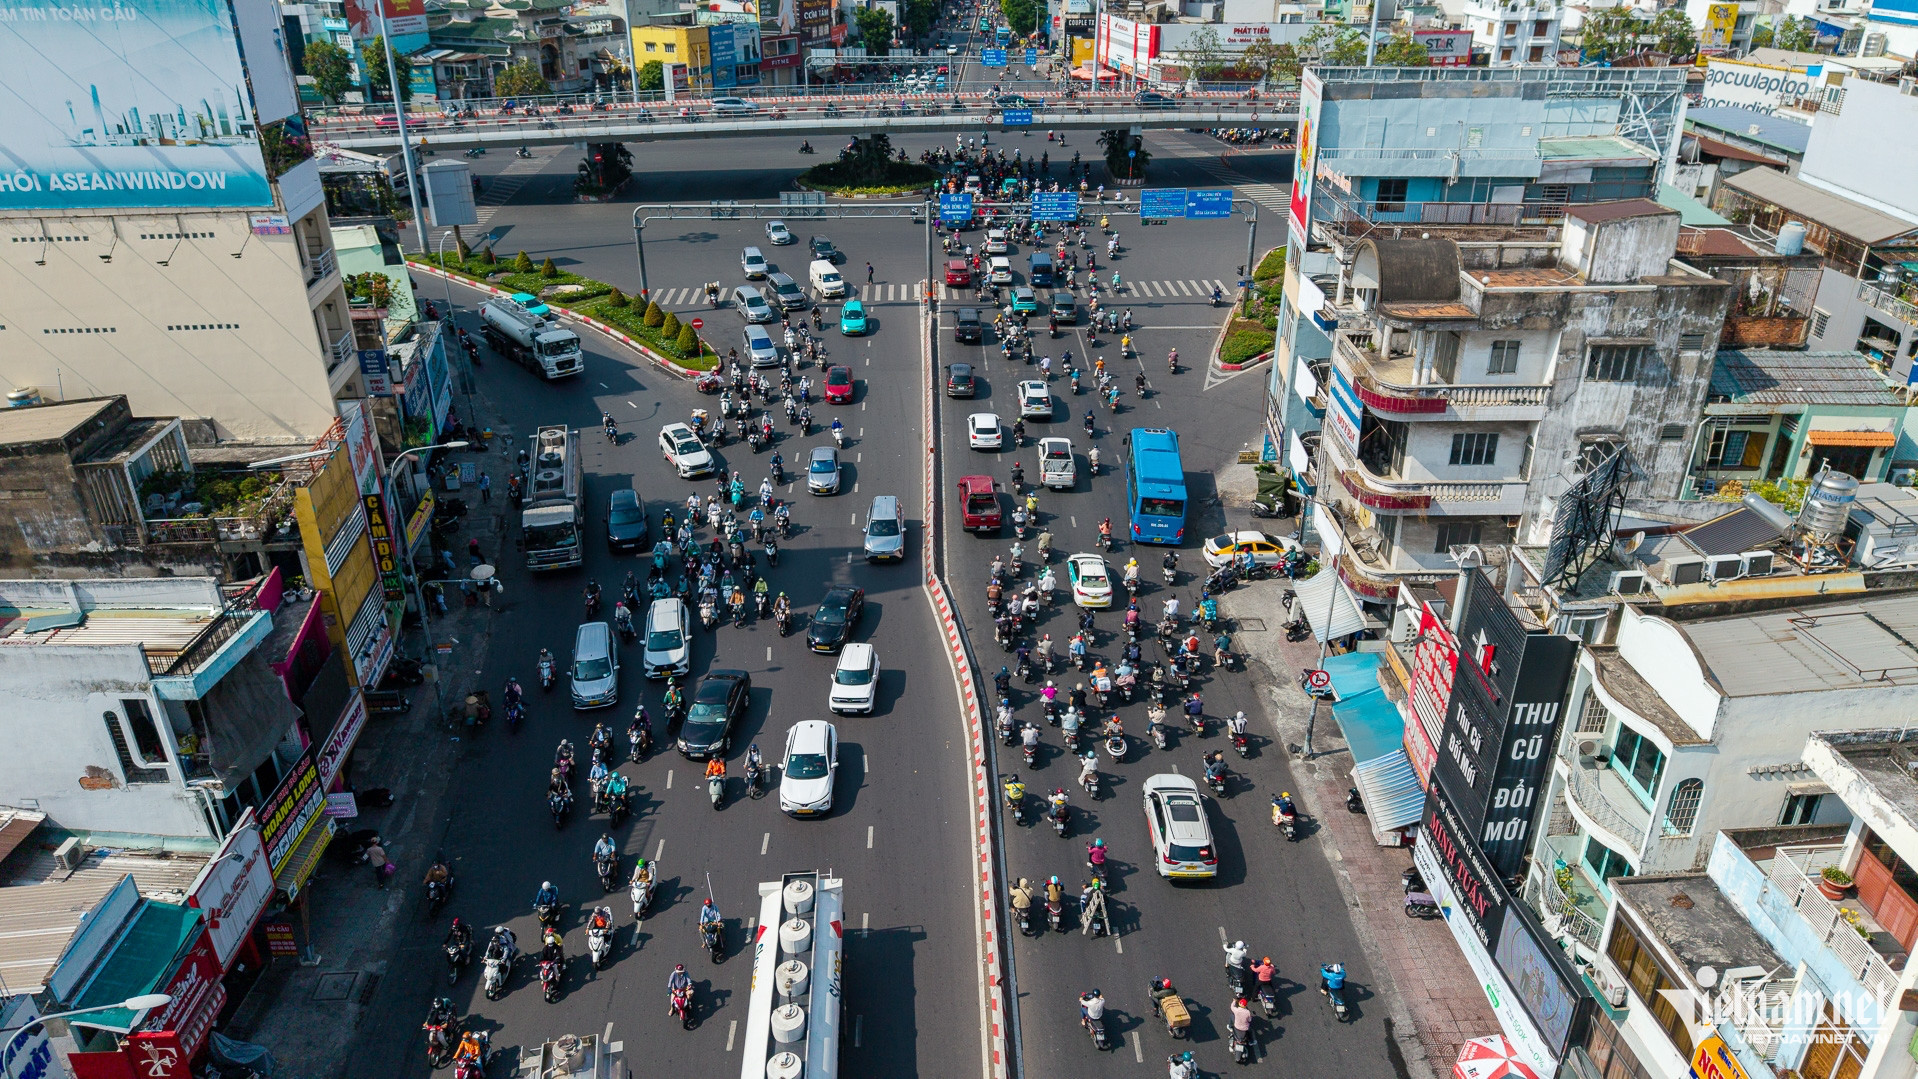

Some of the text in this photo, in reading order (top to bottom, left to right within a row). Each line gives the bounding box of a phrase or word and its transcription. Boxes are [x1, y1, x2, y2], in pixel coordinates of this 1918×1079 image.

[20, 8, 46, 20] TIN
[48, 4, 96, 21] TOÀN
[100, 2, 136, 21] CẦU
[1234, 26, 1252, 34] PHÁT
[1706, 68, 1810, 98] apcuulaptop
[50, 172, 226, 190] ASEANWINDOW
[378, 542, 393, 571] ĐỒ
[1514, 702, 1558, 724] THU
[1456, 702, 1482, 754] Thu Cũ
[1449, 732, 1477, 788] Đổi Mới
[1512, 735, 1542, 760] CŨ
[262, 791, 294, 844] HOÀNG
[293, 762, 316, 802] LONG
[1494, 779, 1534, 808] ĐỔI
[1484, 817, 1528, 842] MỚI
[1428, 809, 1490, 921] MINH TUẤN
[1471, 853, 1502, 908] SMARTPHONE
[1512, 1020, 1528, 1040] 500K
